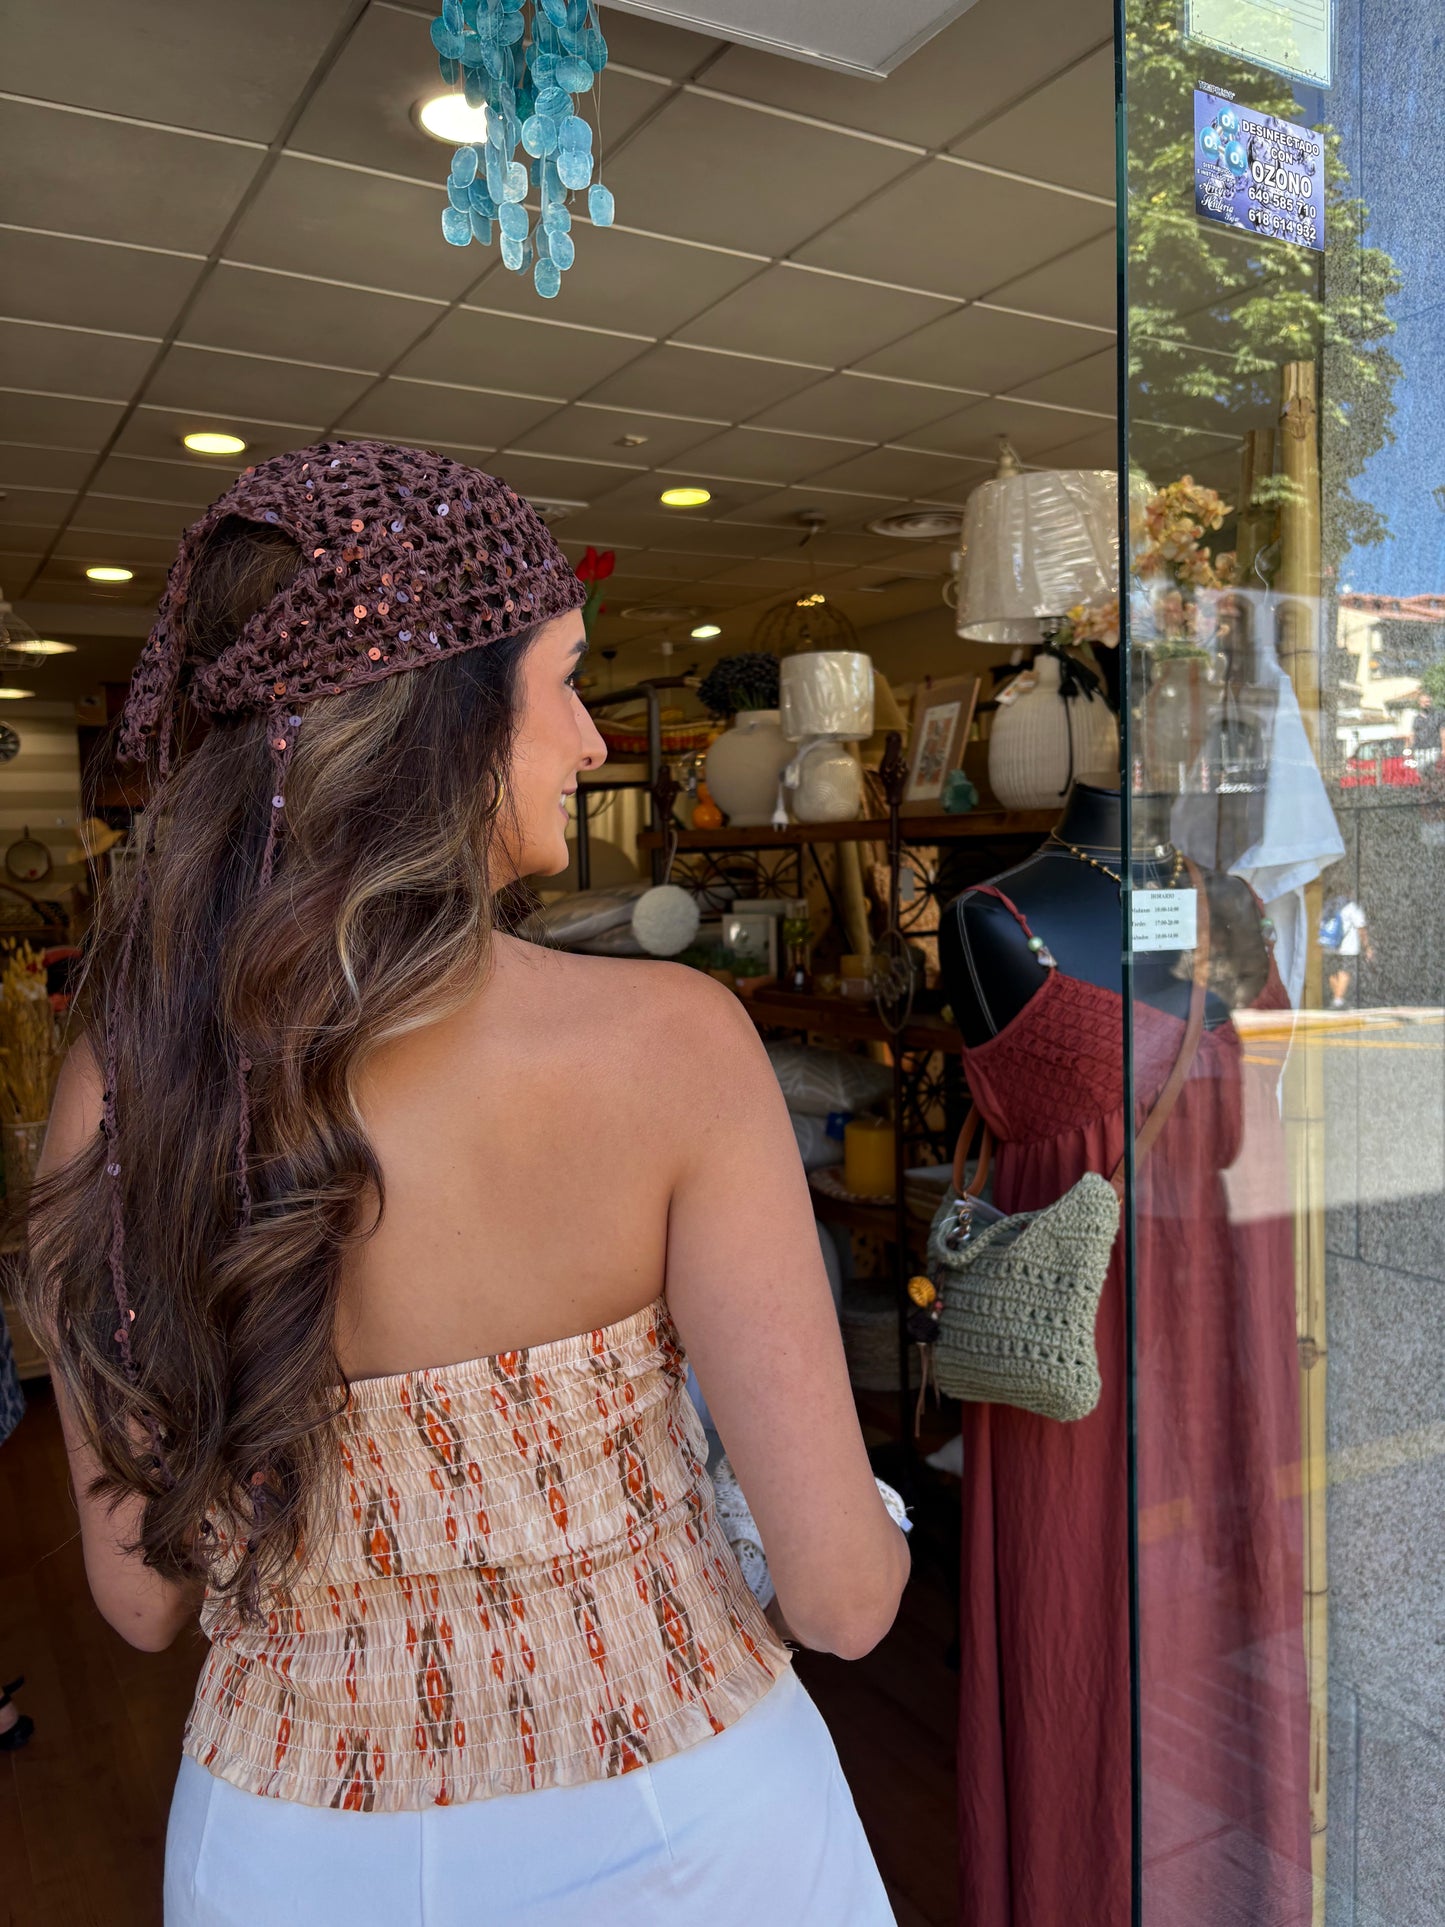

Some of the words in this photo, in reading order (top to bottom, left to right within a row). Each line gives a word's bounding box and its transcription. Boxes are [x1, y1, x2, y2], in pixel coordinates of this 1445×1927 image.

[1242, 119, 1319, 155] DESINFECTADO
[1271, 148, 1293, 164] CON
[1252, 161, 1312, 198] OZONO
[1248, 187, 1270, 204] 649
[1273, 195, 1293, 211] 585
[1296, 201, 1317, 218] 710
[1248, 209, 1270, 226] 618
[1273, 216, 1293, 233] 614
[1296, 223, 1317, 240] 932
